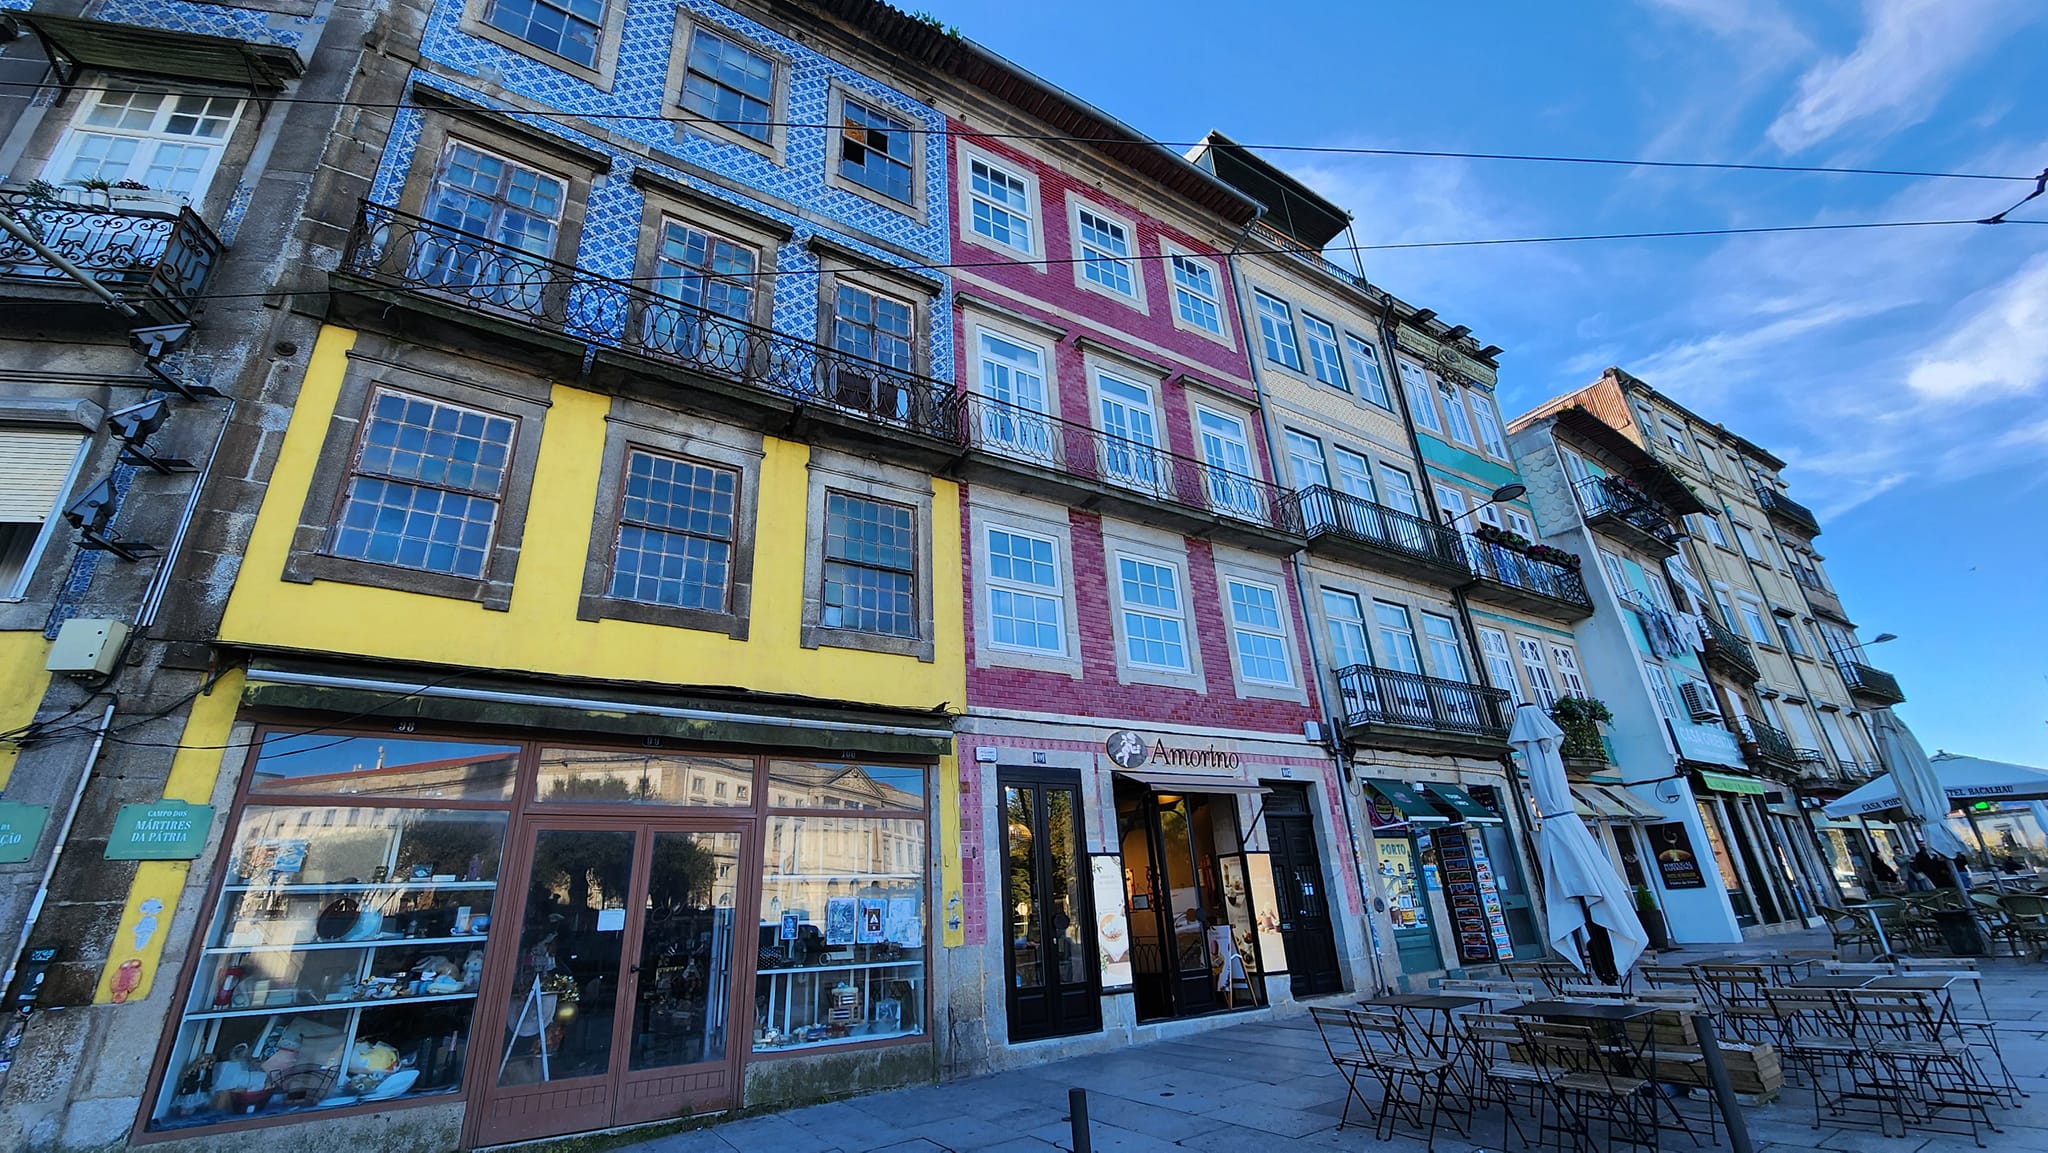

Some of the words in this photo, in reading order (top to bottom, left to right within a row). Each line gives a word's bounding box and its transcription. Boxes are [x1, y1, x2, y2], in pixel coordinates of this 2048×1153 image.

[1150, 737, 1240, 770] Amorino
[1967, 784, 2014, 796] BACALHAU
[1862, 801, 1882, 811] CASA
[172, 809, 188, 817] DOS
[135, 819, 192, 831] MÁRTIRES
[0, 832, 22, 846] ÇÃO
[131, 832, 145, 842] DA
[149, 831, 188, 842] PÁTRIA
[1380, 843, 1406, 856] PORTO
